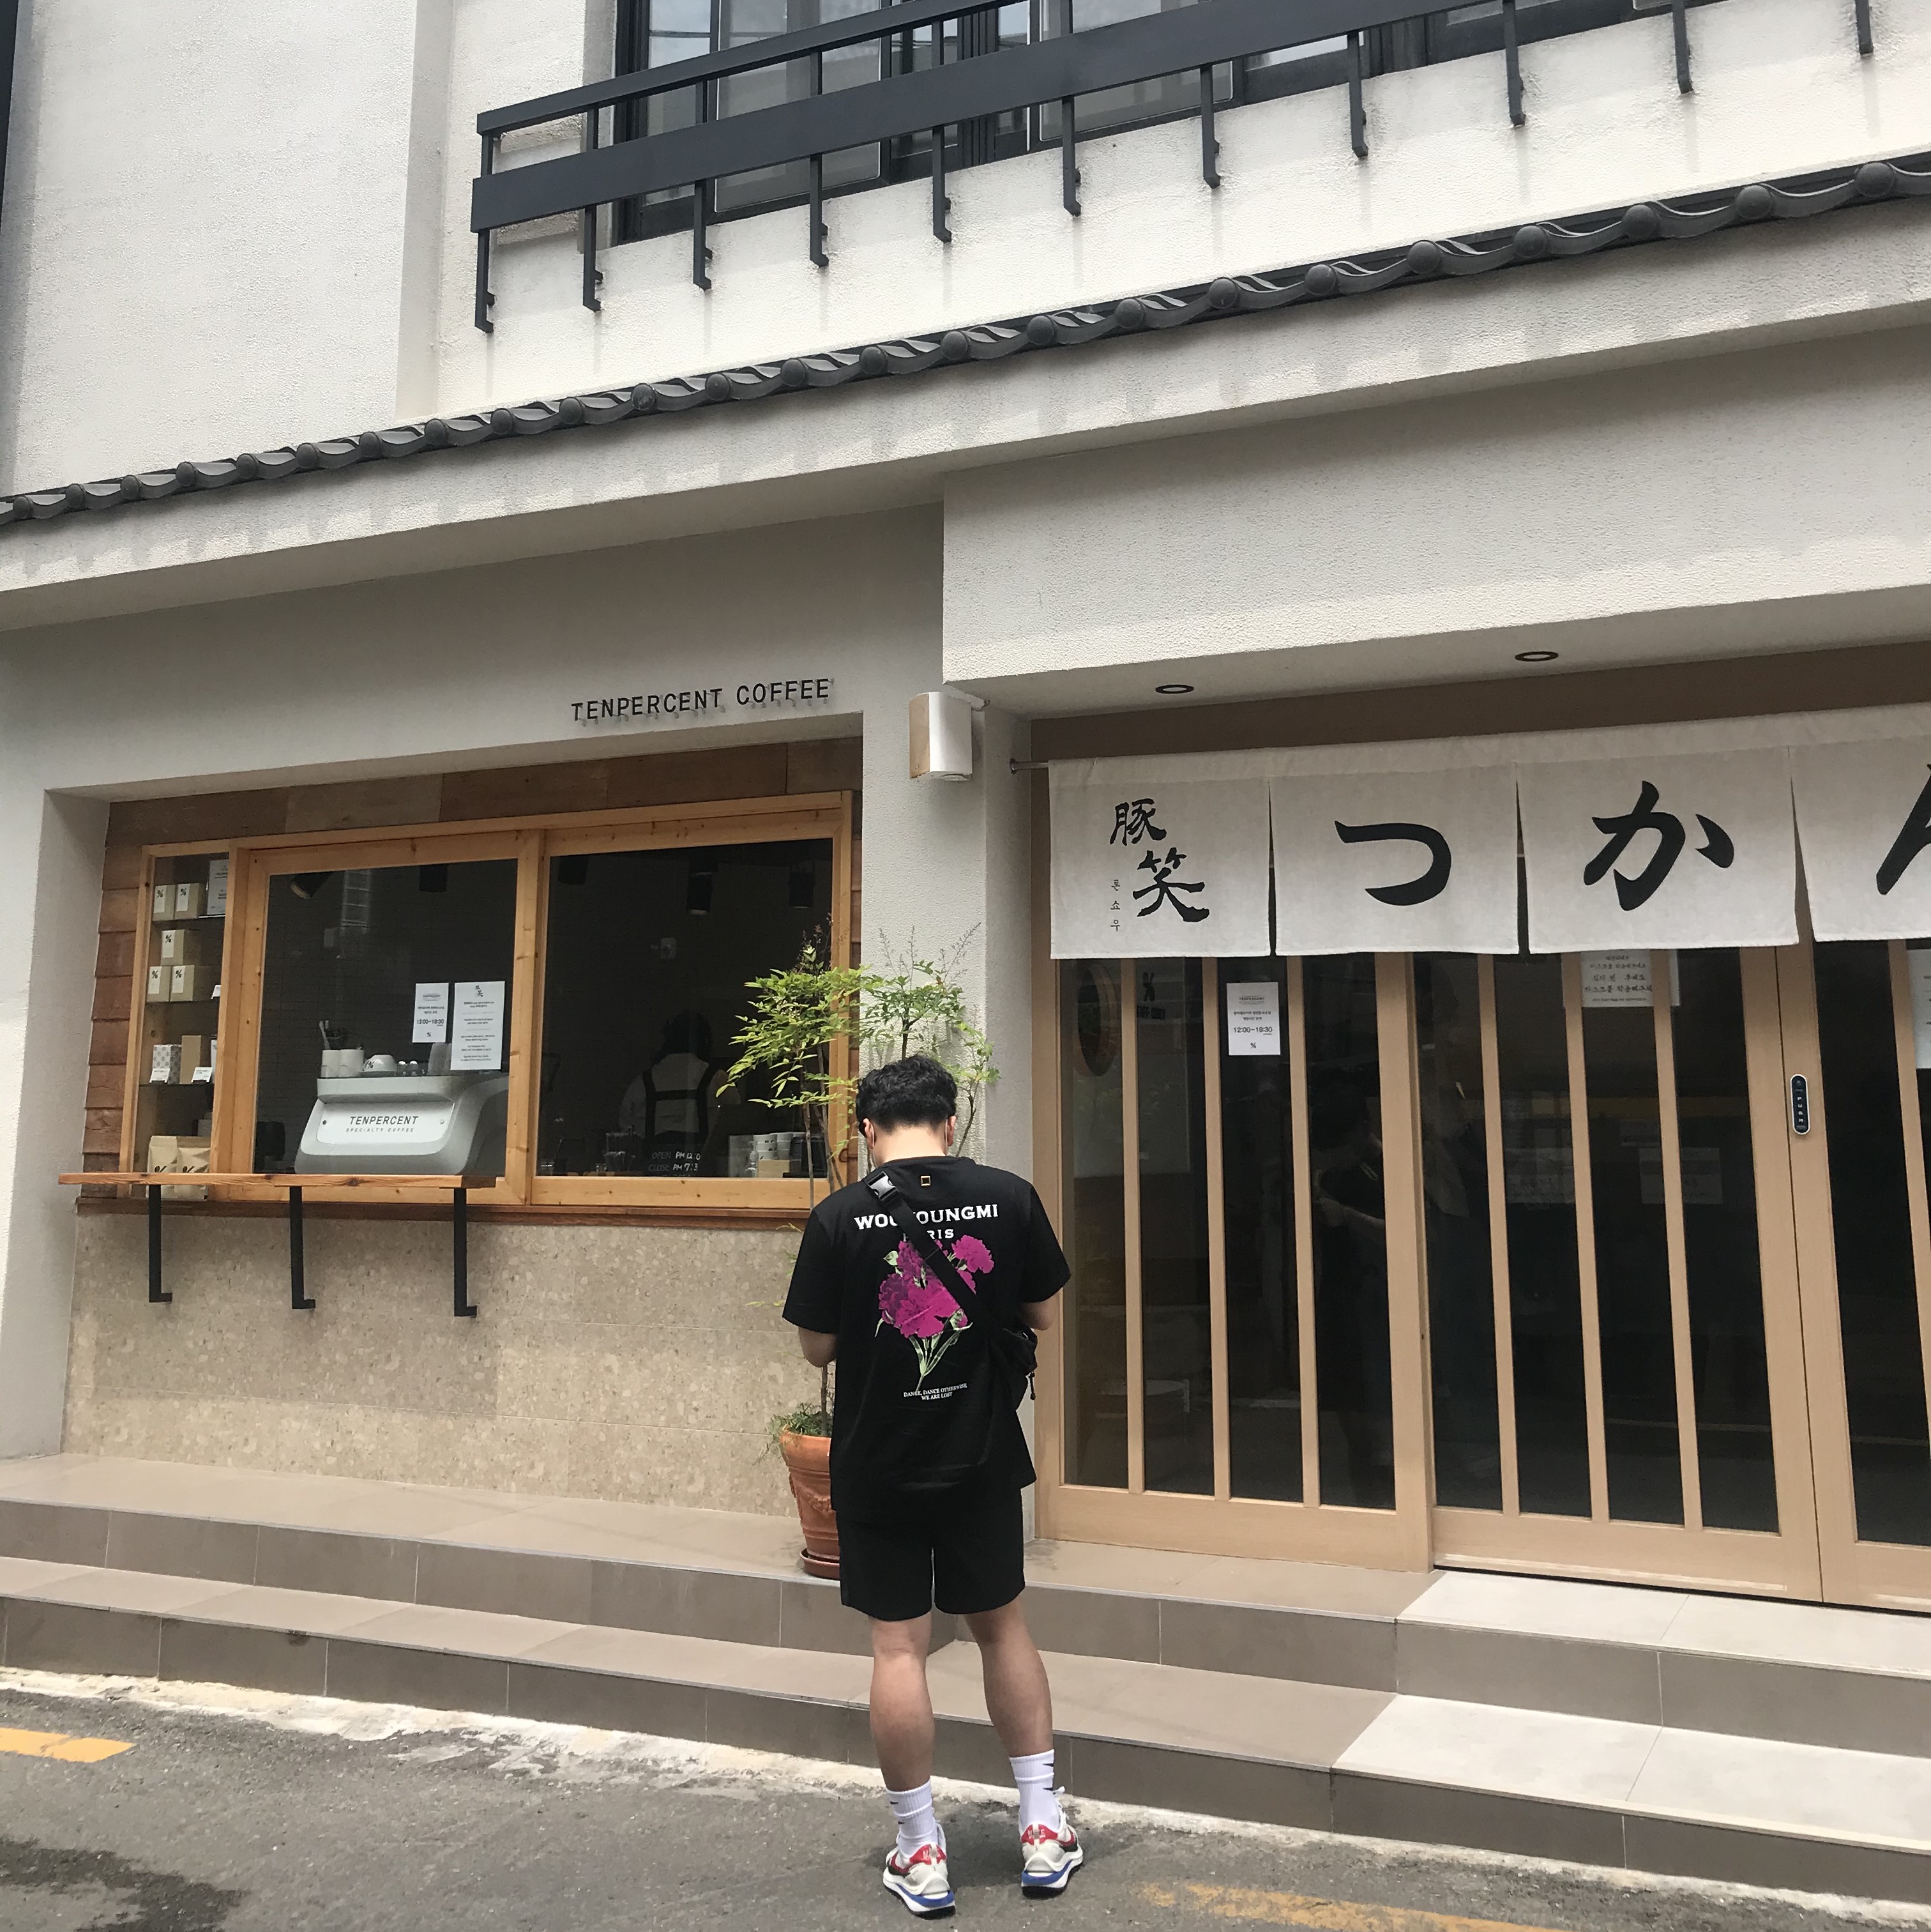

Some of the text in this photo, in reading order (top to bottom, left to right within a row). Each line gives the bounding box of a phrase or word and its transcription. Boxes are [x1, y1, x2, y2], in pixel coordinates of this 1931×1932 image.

[572, 679, 829, 720] TENPERCENT COFFEE
[350, 1116, 418, 1125] TENPERCENT
[675, 1151, 685, 1159] PM
[854, 1204, 999, 1230] WOOUNGMI
